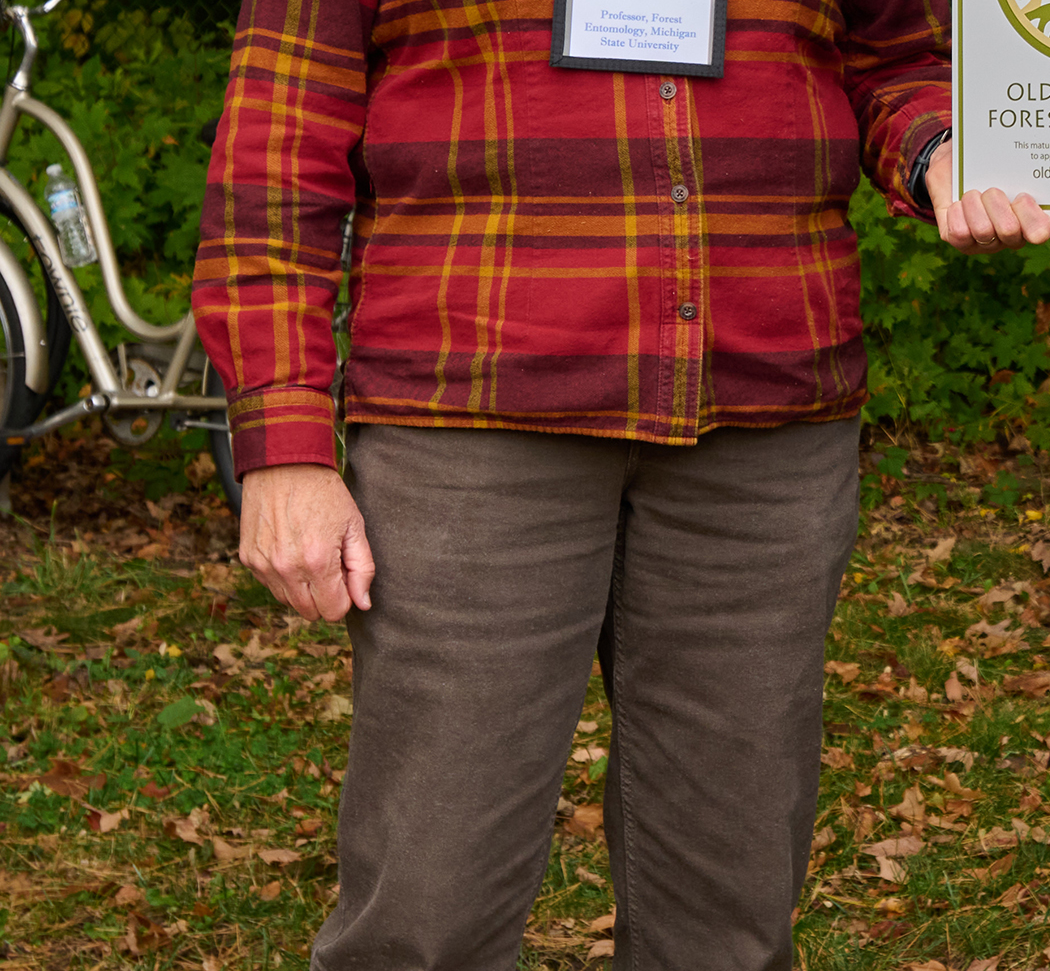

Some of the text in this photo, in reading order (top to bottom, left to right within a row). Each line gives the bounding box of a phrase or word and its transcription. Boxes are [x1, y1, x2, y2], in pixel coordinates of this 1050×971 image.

[600, 10, 682, 24] Professor, Forest
[584, 22, 696, 40] Entomology, Michigan
[600, 37, 680, 52] State University
[34, 234, 88, 332] townie
